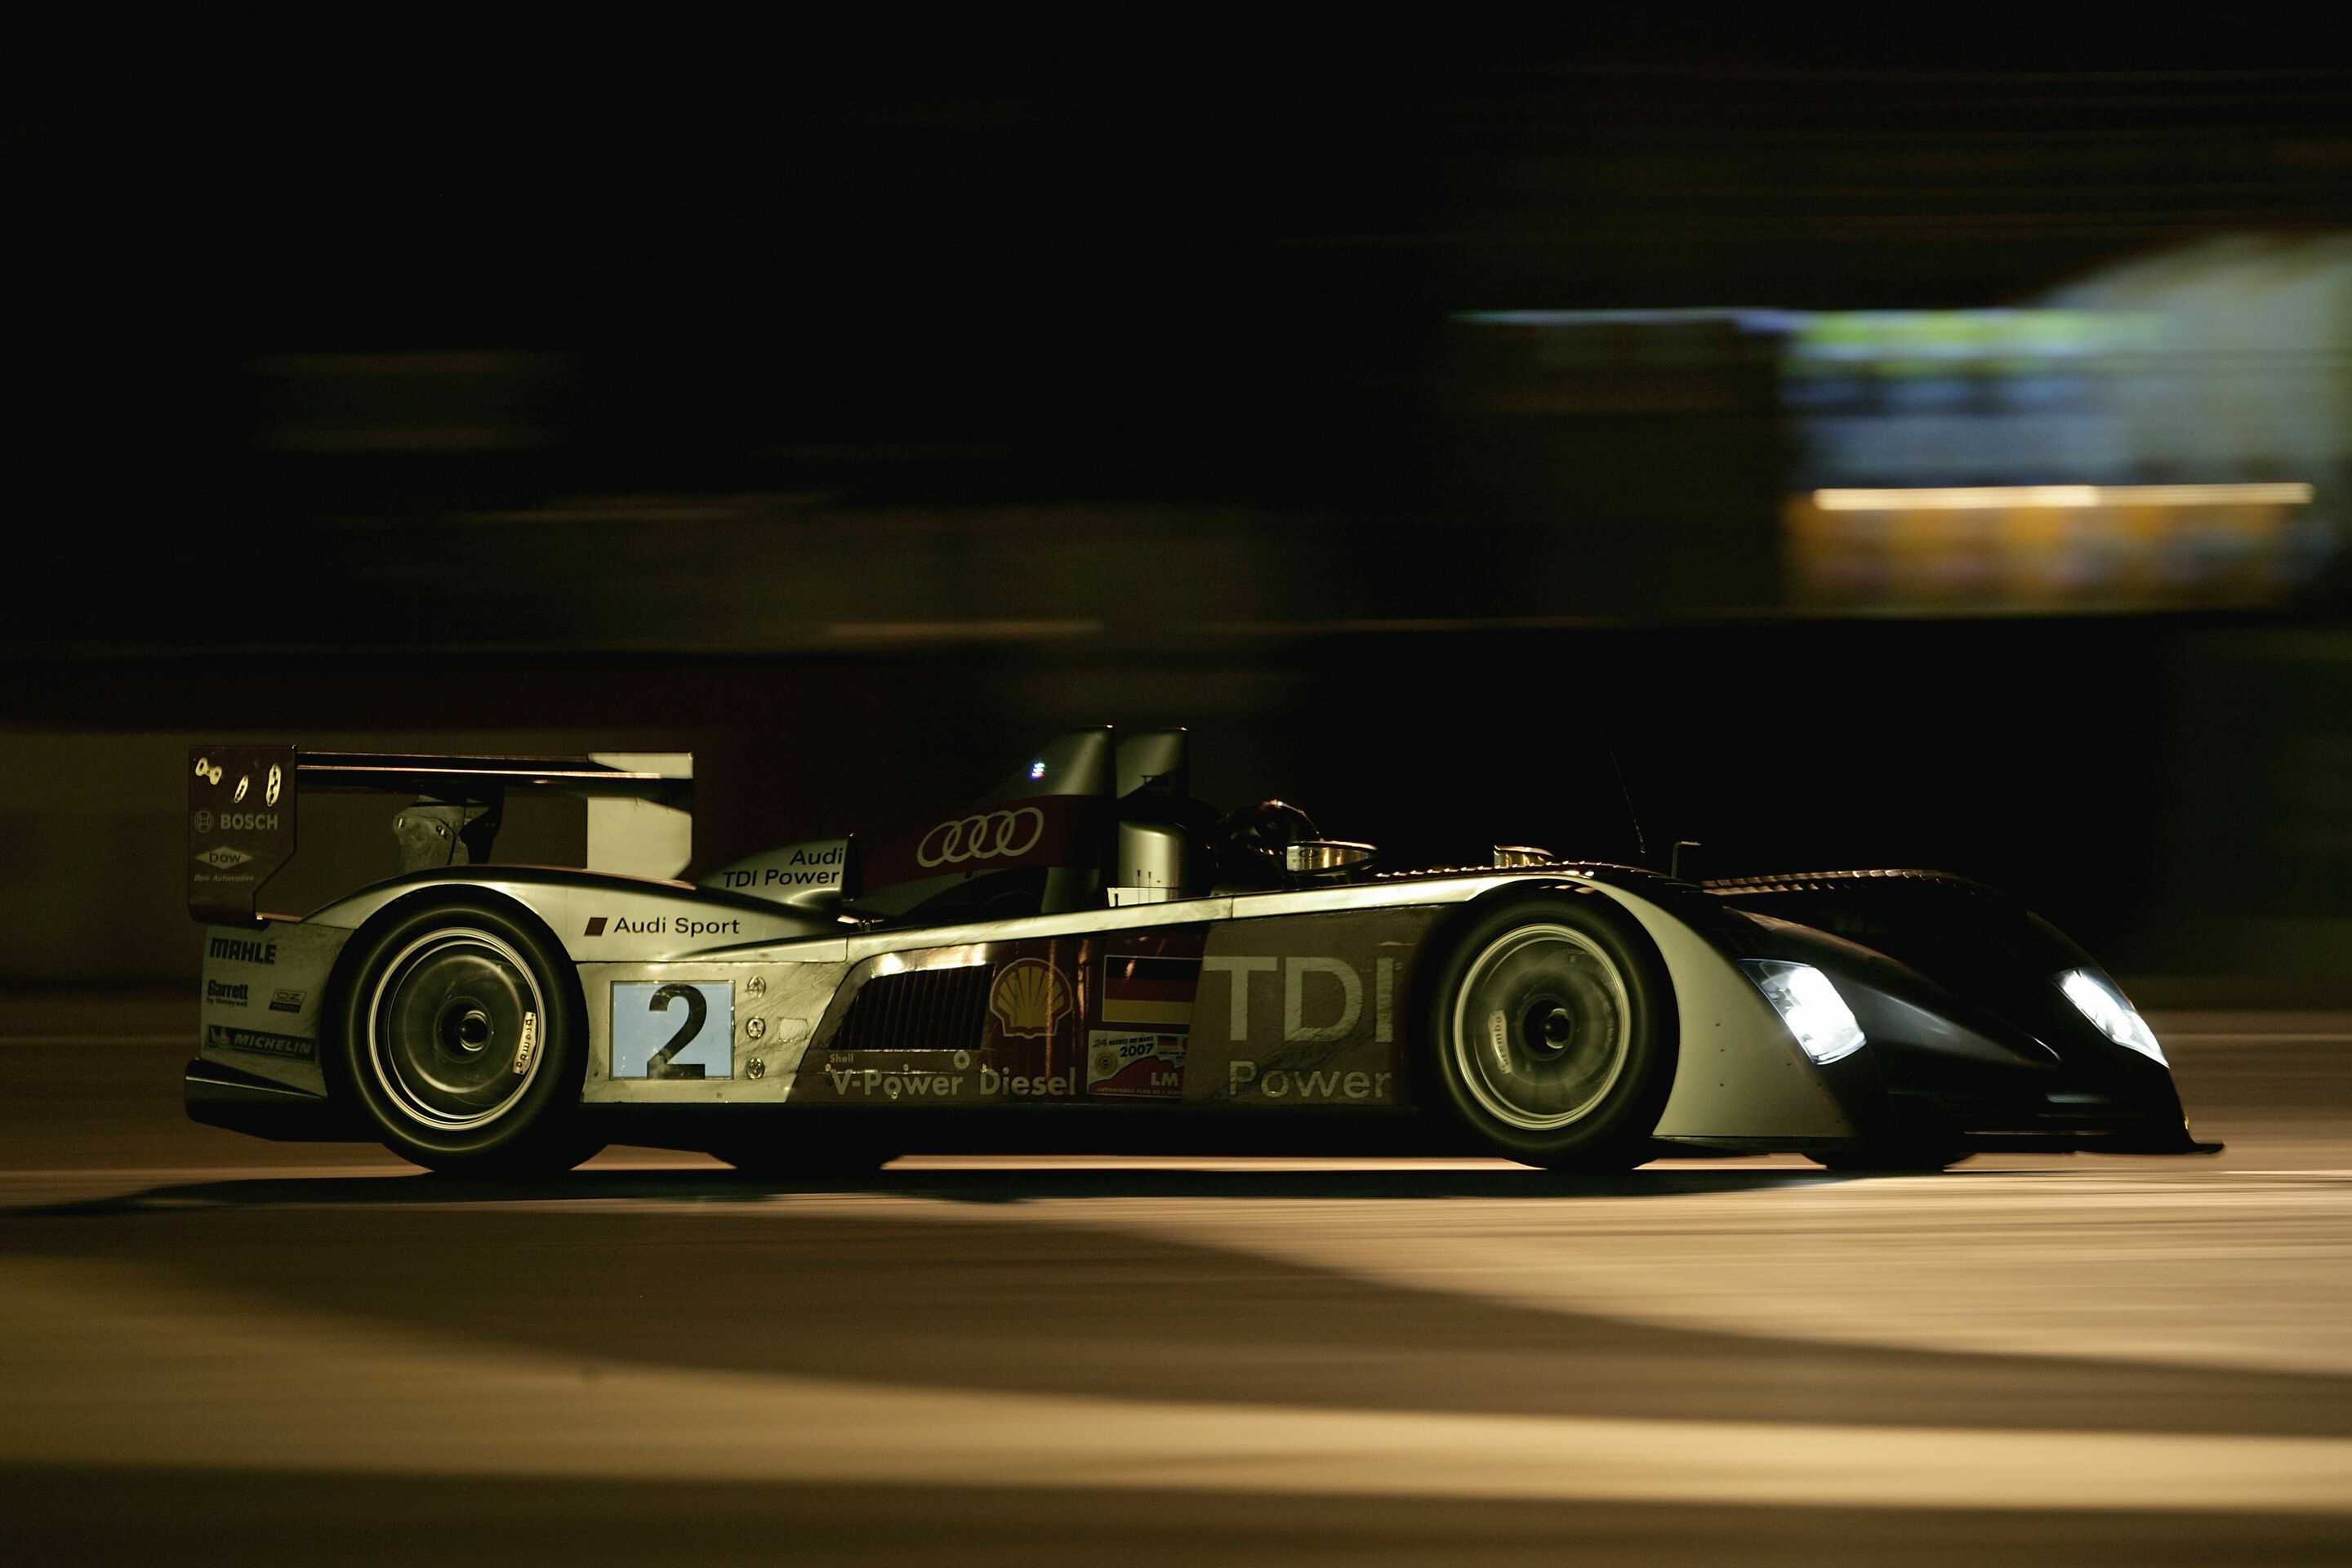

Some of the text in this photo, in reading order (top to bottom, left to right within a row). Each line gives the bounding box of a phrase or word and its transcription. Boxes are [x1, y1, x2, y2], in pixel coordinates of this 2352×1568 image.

[220, 813, 278, 831] BOSCH
[789, 848, 844, 865] Audi
[724, 868, 840, 888] TDI Power
[613, 917, 740, 937] Audi Sport
[209, 938, 277, 964] MAHLE
[1202, 956, 1394, 1043] TDI
[647, 983, 707, 1080] 2
[234, 1031, 312, 1054] MICHELIN
[1120, 1043, 1154, 1058] 2007
[829, 1054, 854, 1063] Shell
[830, 1066, 1076, 1096] V-Power Diesel
[1151, 1071, 1179, 1088] LM
[1229, 1061, 1392, 1098] Power
